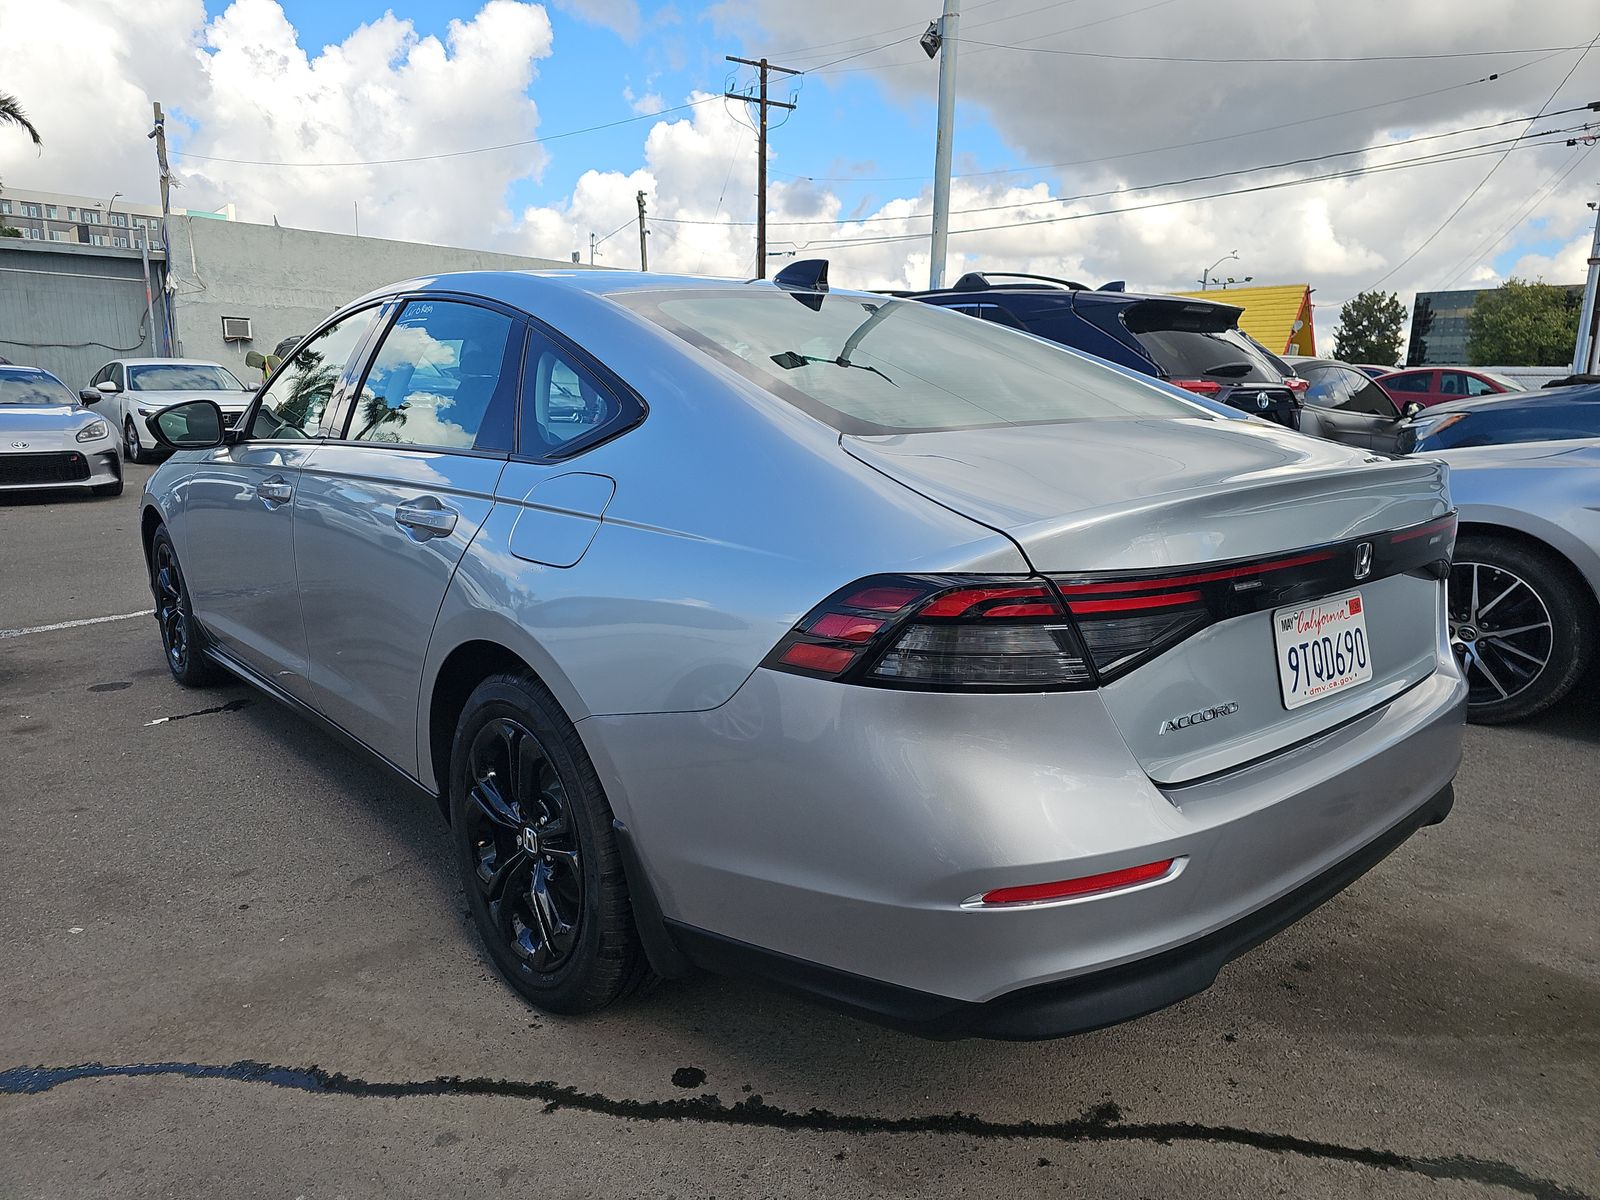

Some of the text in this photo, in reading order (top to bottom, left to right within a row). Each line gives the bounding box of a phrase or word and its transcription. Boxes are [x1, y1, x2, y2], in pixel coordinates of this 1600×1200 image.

[1281, 607, 1350, 635] MAY California
[1288, 627, 1366, 693] 9TQD690
[1309, 675, 1353, 696] dmv.ca.gov
[1159, 701, 1239, 735] ACCORD
